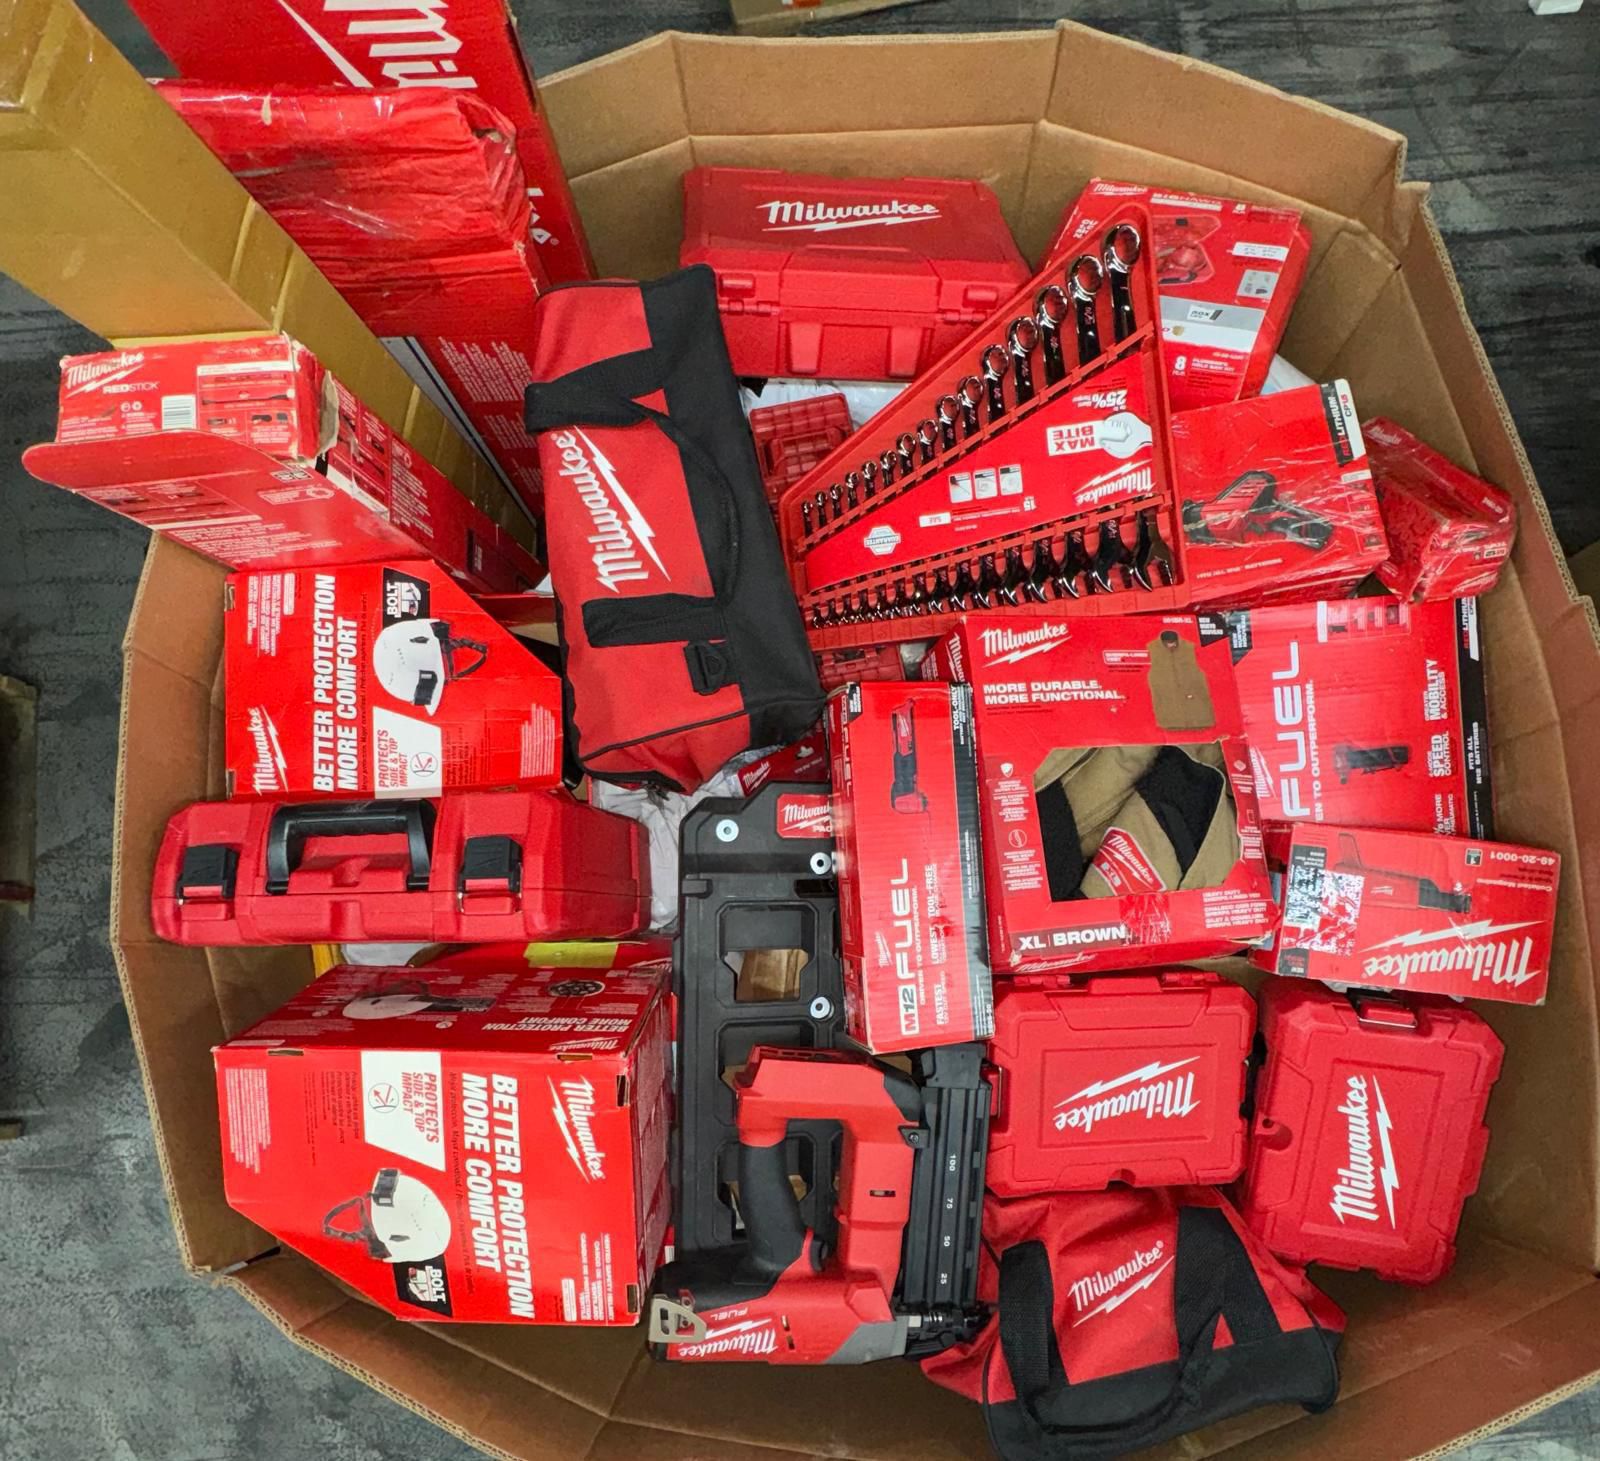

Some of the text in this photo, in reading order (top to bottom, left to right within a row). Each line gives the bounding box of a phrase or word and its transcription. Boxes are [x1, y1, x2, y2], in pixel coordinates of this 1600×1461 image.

[756, 200, 939, 224] Milwaukee
[65, 352, 145, 389] Milwaukee
[1173, 356, 1187, 371] 8
[1092, 389, 1127, 409] 25%
[1052, 425, 1094, 439] BITE
[1055, 436, 1095, 452] MAX
[1075, 466, 1157, 506] Milwaukee
[556, 430, 649, 594] Milwaukee
[386, 582, 399, 616] BOLT
[977, 623, 1068, 657] Milwaukee
[313, 574, 336, 791] BETTER PROTECTION
[983, 679, 1102, 693] MORE DURABLE.
[984, 689, 1126, 705] MORE FUNCTIONAL.
[1425, 658, 1440, 721] MOBILITY
[1438, 672, 1448, 711] ACCESS
[336, 617, 358, 791] MORE COMFORT
[951, 685, 960, 731] TOOL-ONLY
[1272, 641, 1310, 817] FUEL
[1305, 679, 1321, 778] OUTPERFORM.
[1472, 722, 1481, 765] BATTERIES
[248, 706, 280, 796] Milwaukee
[377, 729, 389, 788] PROTECTS
[389, 738, 399, 787] SIDE & TOP
[398, 753, 408, 787] IMPACT
[1431, 734, 1444, 777] SPEED
[1442, 730, 1452, 777] CONTROL
[1313, 779, 1323, 799] TO
[1434, 793, 1444, 822] MORE
[1109, 833, 1155, 883] Milwaukee
[1490, 850, 1556, 865] 49-20-0001
[925, 864, 936, 919] TOOL-FREE
[912, 885, 923, 952] OUTPERFORM.
[1018, 924, 1126, 951] XL BROWN
[890, 858, 916, 1031] M12 FUEL
[917, 955, 924, 966] TO
[929, 926, 940, 965] LOWEST
[1364, 936, 1542, 987] Milwaukee
[517, 1016, 588, 1025] COMFORT
[934, 983, 945, 1025] FASTEST
[481, 1022, 630, 1033] BETTER PROTECTION
[549, 1040, 621, 1052] Milwaukee
[401, 1072, 414, 1115] IMPACT
[413, 1072, 426, 1133] SIDE & TOP
[424, 1072, 439, 1144] PROTECTS
[1053, 1072, 1200, 1132] Milwaukee
[560, 1074, 606, 1181] Milwaukee
[949, 1154, 957, 1172] 100
[1330, 1074, 1379, 1224] Milwaukee
[461, 1072, 502, 1273] MORE COMFORT
[492, 1074, 536, 1320] BETTER PROTECTION
[946, 1197, 954, 1210] 75
[943, 1235, 951, 1247] 50
[431, 1266, 445, 1305] BOLT
[940, 1273, 948, 1285] 25
[1066, 1244, 1164, 1312] Milwaukee
[709, 1306, 748, 1321] FUEL
[678, 1328, 779, 1357] Milwaukee
